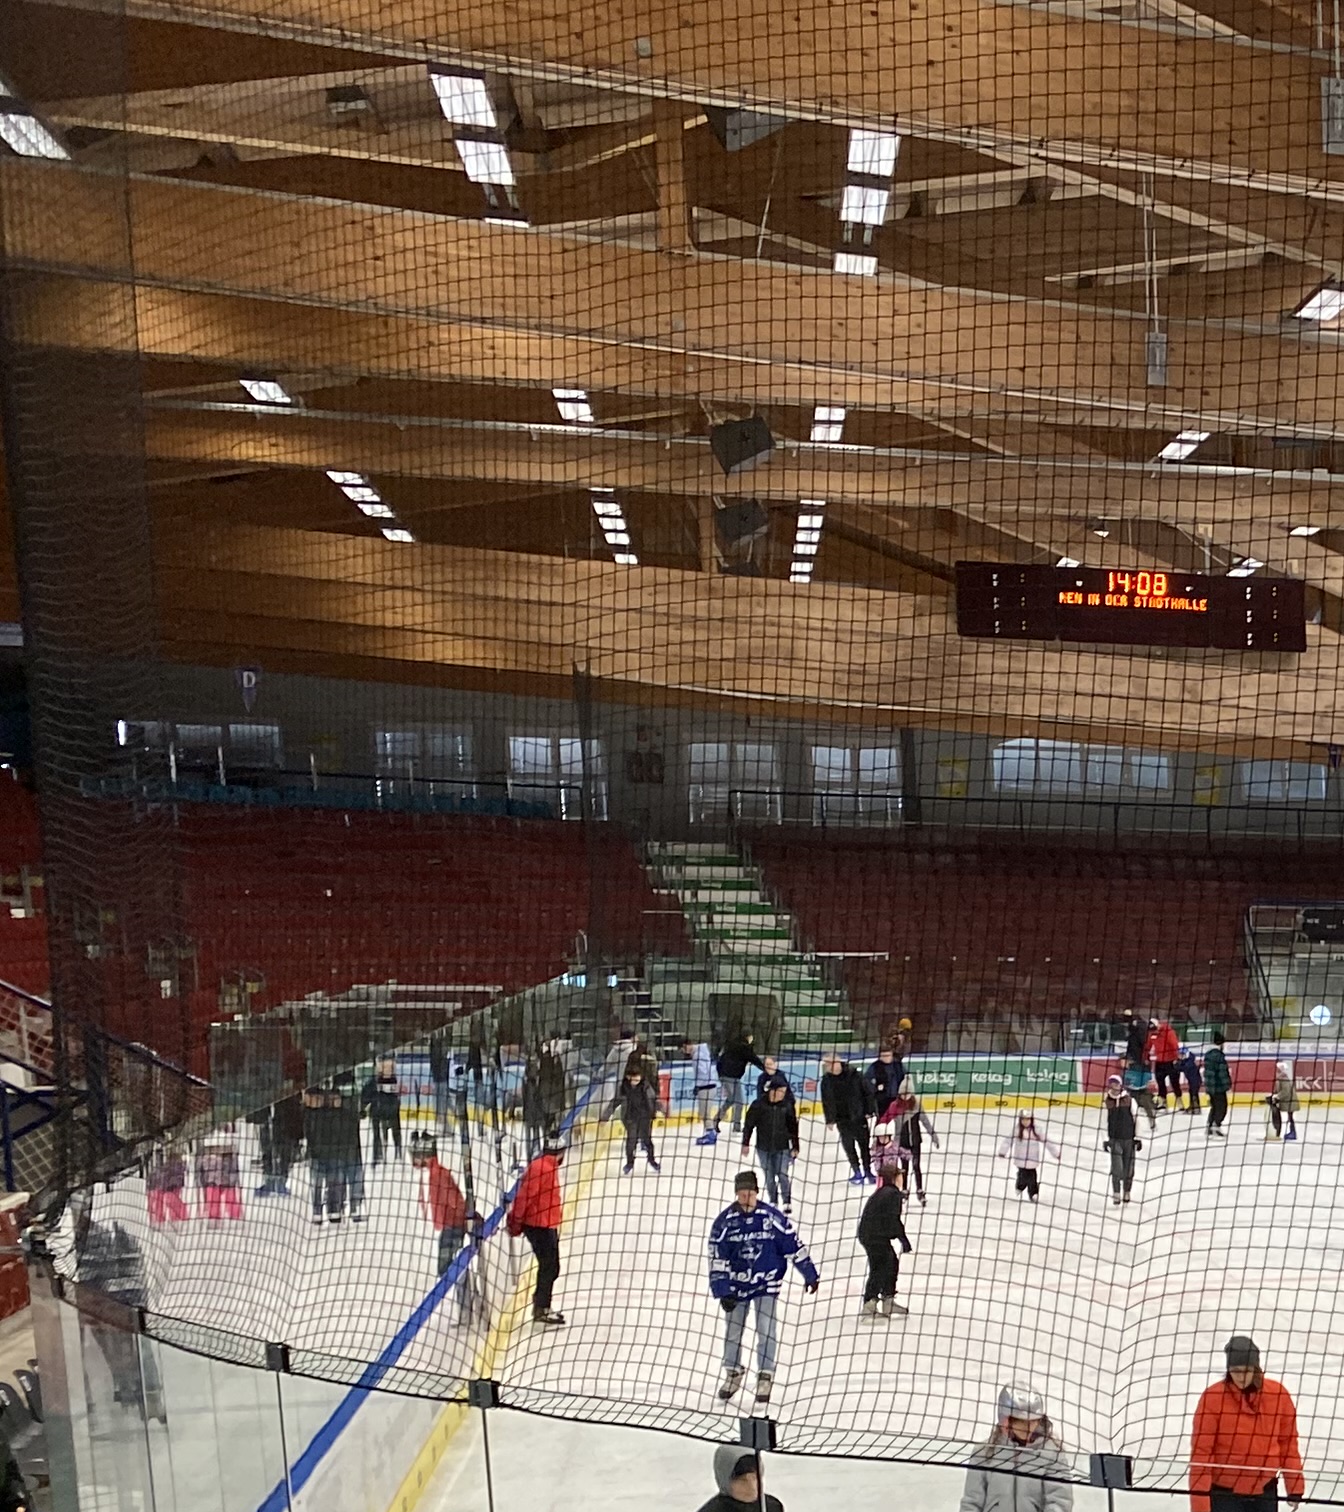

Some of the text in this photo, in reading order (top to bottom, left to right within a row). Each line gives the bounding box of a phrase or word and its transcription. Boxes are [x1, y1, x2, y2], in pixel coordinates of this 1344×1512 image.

[1108, 571, 1168, 596] 14:08
[1088, 594, 1101, 606] IN
[1134, 596, 1208, 612] STADTHALLE
[243, 671, 256, 688] D
[916, 1069, 958, 1087] kelag
[971, 1070, 1013, 1087] kelag
[1026, 1067, 1070, 1086] kelag
